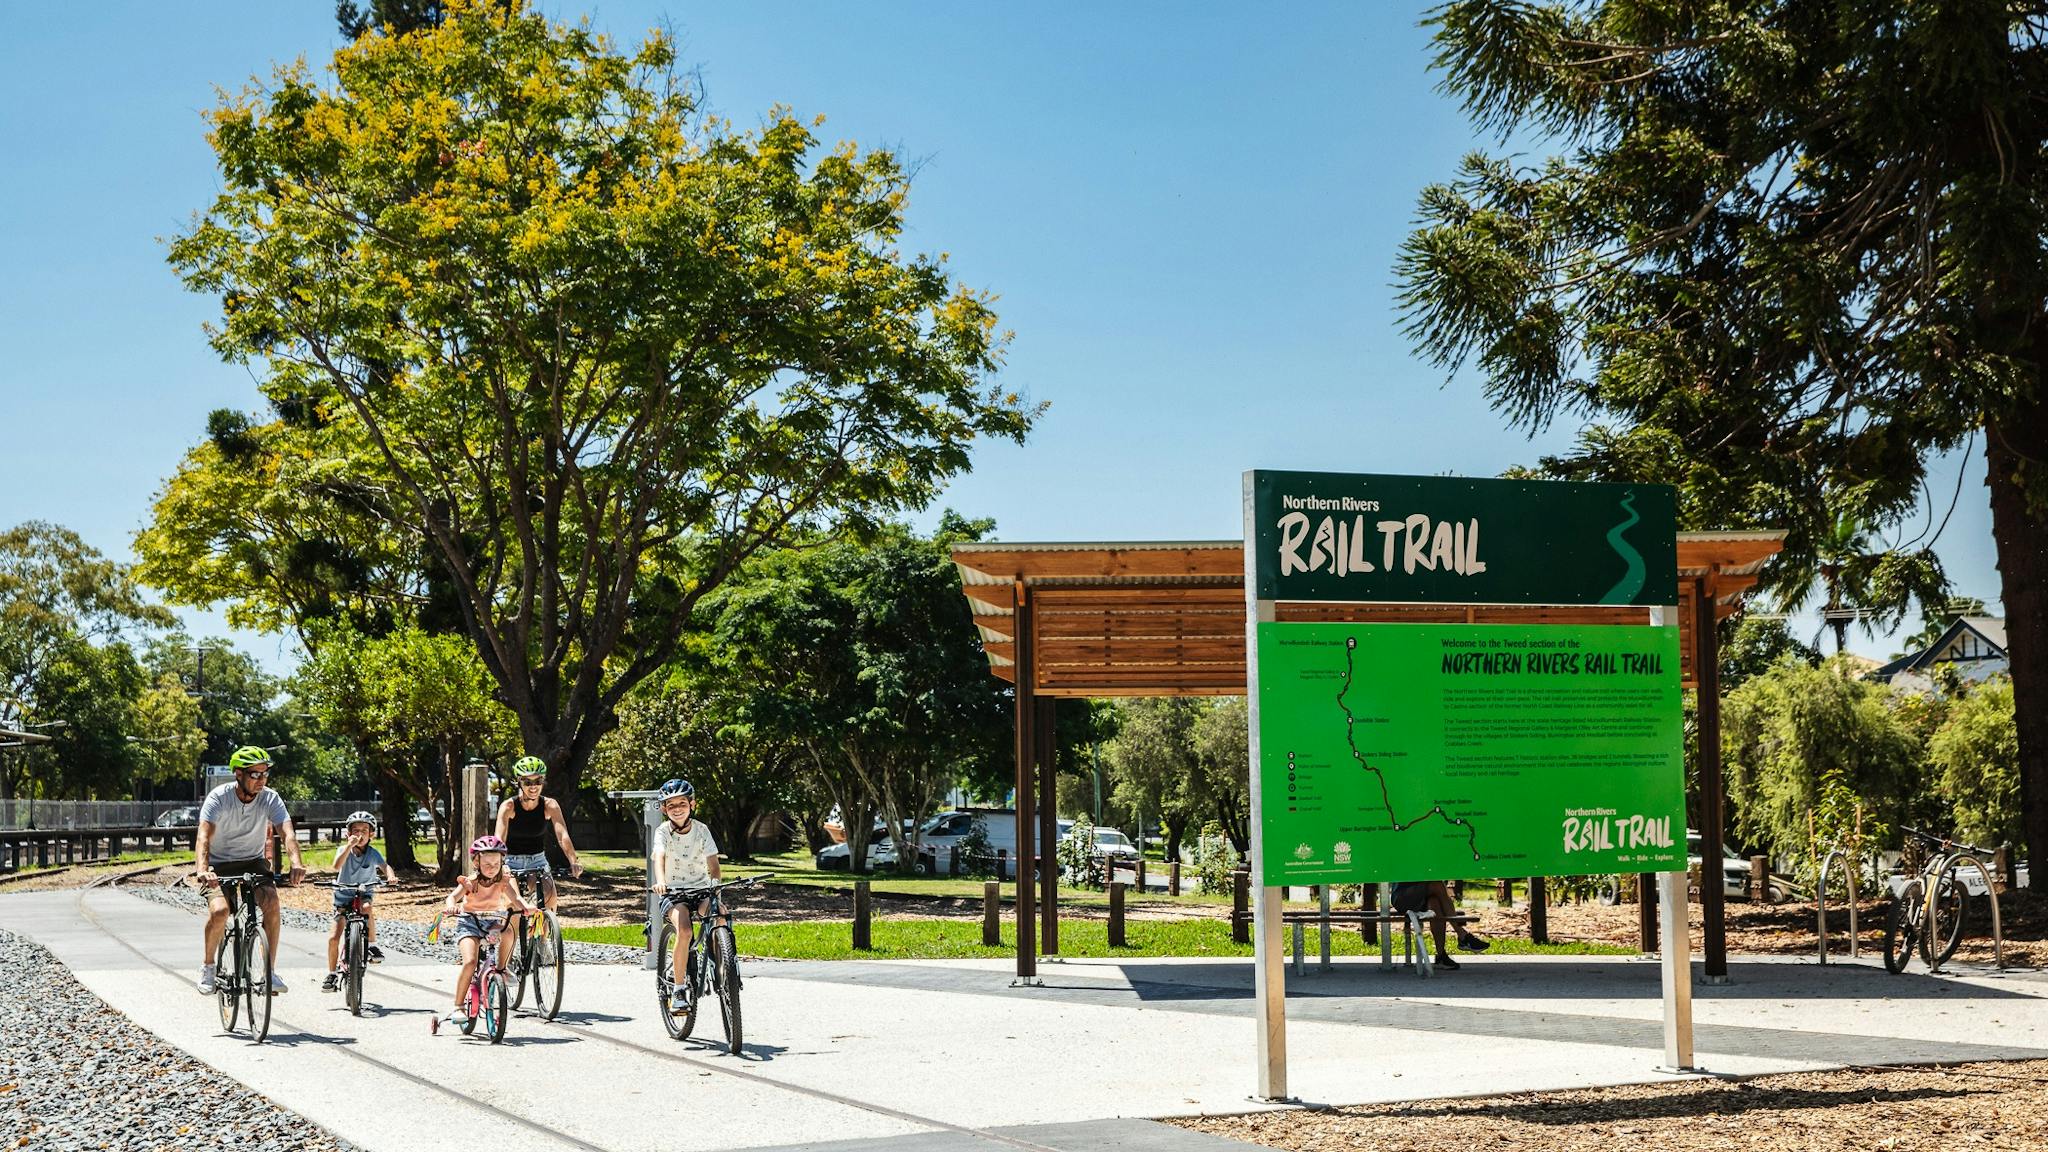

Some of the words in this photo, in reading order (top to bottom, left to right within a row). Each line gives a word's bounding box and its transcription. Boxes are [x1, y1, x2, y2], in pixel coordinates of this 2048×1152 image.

[1283, 495, 1340, 510] Northern
[1342, 497, 1380, 512] Rivers
[1277, 511, 1375, 577] RAIL
[1376, 514, 1486, 576] TRAIL
[1441, 639, 1477, 648] Welcome
[1478, 640, 1487, 648] to
[1488, 639, 1500, 648] the
[1503, 639, 1528, 648] Tweed
[1529, 639, 1556, 648] section
[1558, 639, 1566, 648] of
[1567, 640, 1580, 648] the
[1441, 652, 1522, 675] NORTHERN
[1526, 652, 1580, 675] RIVERS
[1584, 653, 1617, 675] RAIL
[1621, 652, 1664, 675] TRAIL
[1565, 808, 1595, 817] Northern
[1597, 808, 1617, 816] Rivers
[1562, 817, 1615, 854] RAIL
[1615, 815, 1675, 849] TRAIL
[1334, 854, 1352, 862] NSW
[1655, 854, 1674, 862] Explore
